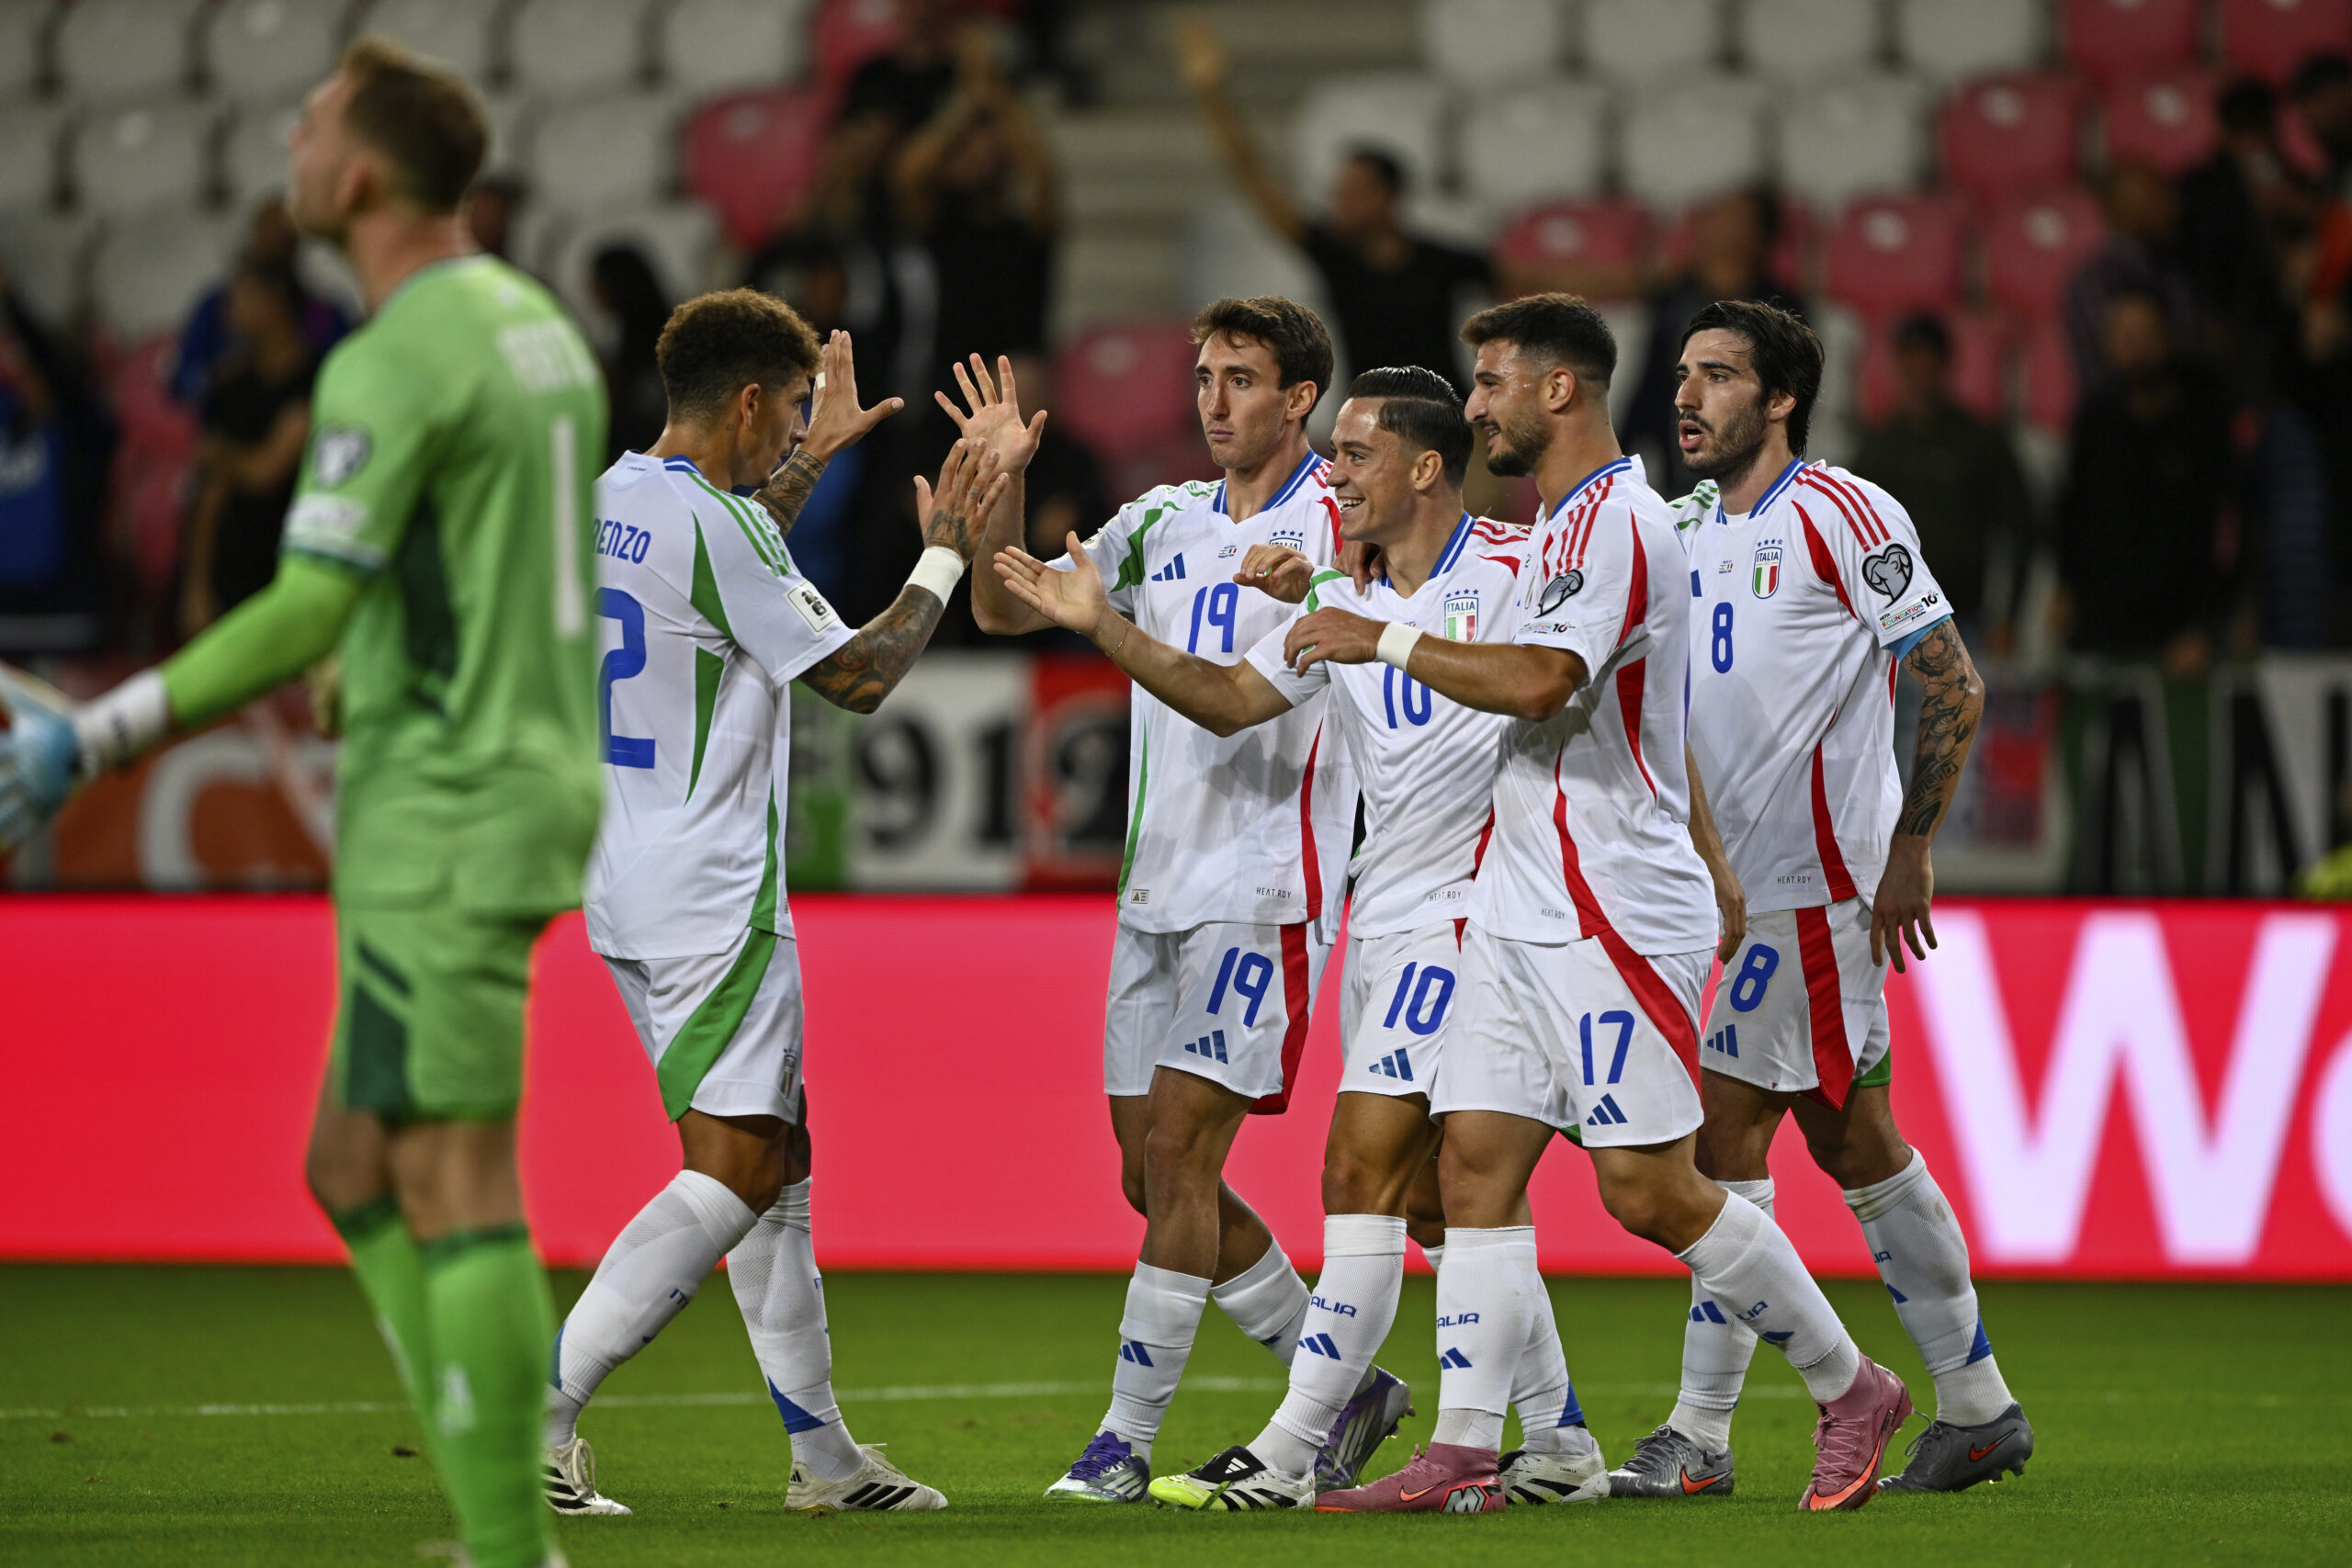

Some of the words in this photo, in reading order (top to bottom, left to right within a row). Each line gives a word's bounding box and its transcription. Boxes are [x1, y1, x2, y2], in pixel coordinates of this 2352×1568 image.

[552, 412, 587, 639] 1
[1757, 551, 1779, 562] ITALIA
[1187, 581, 1239, 655] 19
[1447, 601, 1476, 613] ITALIA
[1712, 602, 1734, 674] 8
[1882, 604, 1924, 627] FOUNDATION
[594, 586, 656, 769] 2
[1383, 663, 1432, 729] 10
[1256, 886, 1292, 899] HEAT.RDY
[1777, 875, 1812, 885] HEAT.RDY
[1206, 947, 1274, 1029] 19
[1383, 961, 1456, 1036] 10
[1730, 943, 1780, 1013] 8
[1579, 1010, 1635, 1086] 17
[1916, 904, 2352, 1268] W
[1311, 1295, 1357, 1318] ALIA
[1437, 1313, 1480, 1329] ALIA
